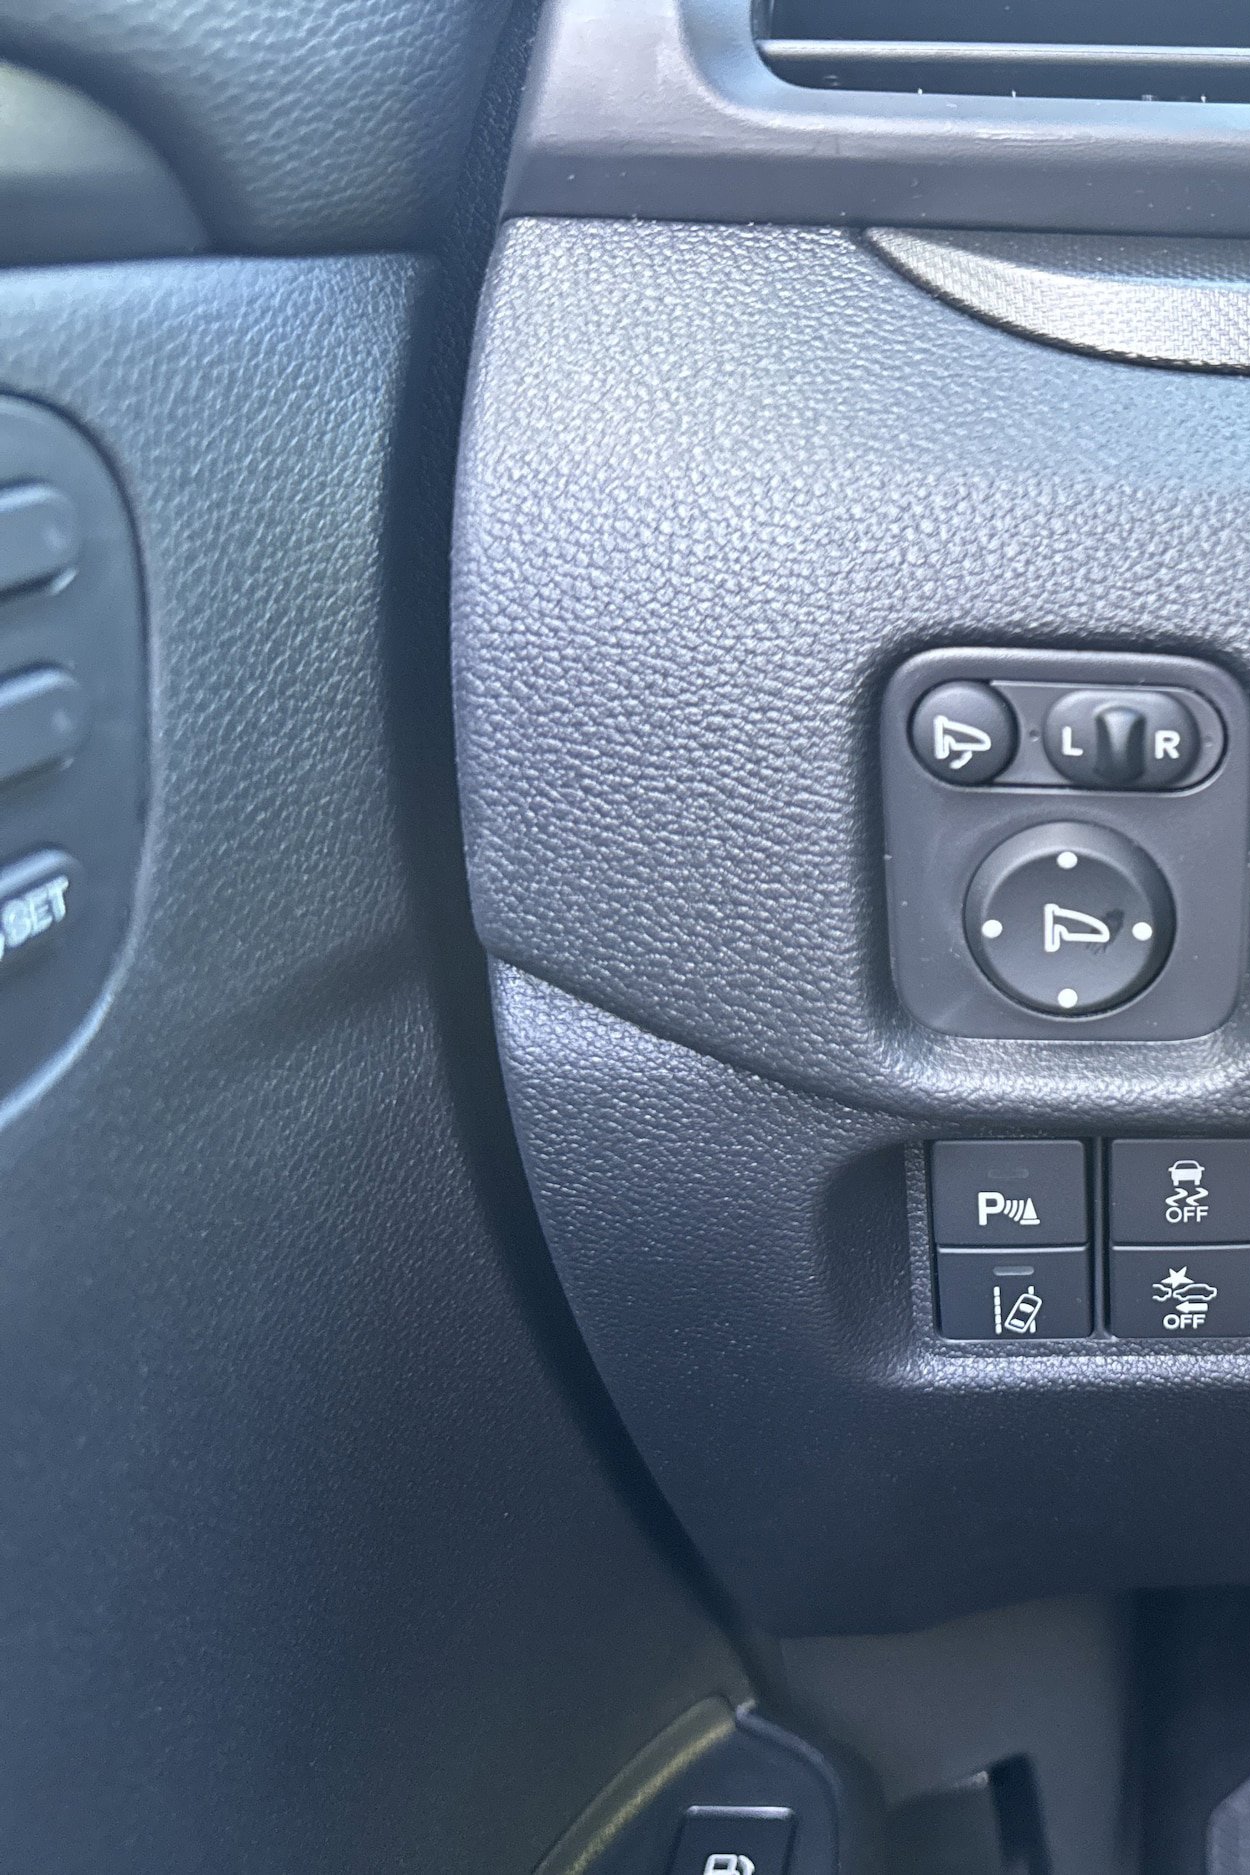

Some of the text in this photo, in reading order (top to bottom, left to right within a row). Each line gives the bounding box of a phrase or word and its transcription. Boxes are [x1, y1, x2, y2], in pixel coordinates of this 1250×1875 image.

[1061, 725, 1181, 760] L R
[2, 874, 70, 948] SET
[977, 1191, 1004, 1226] P
[1165, 1206, 1209, 1223] OFF
[1163, 1313, 1206, 1330] OFF
